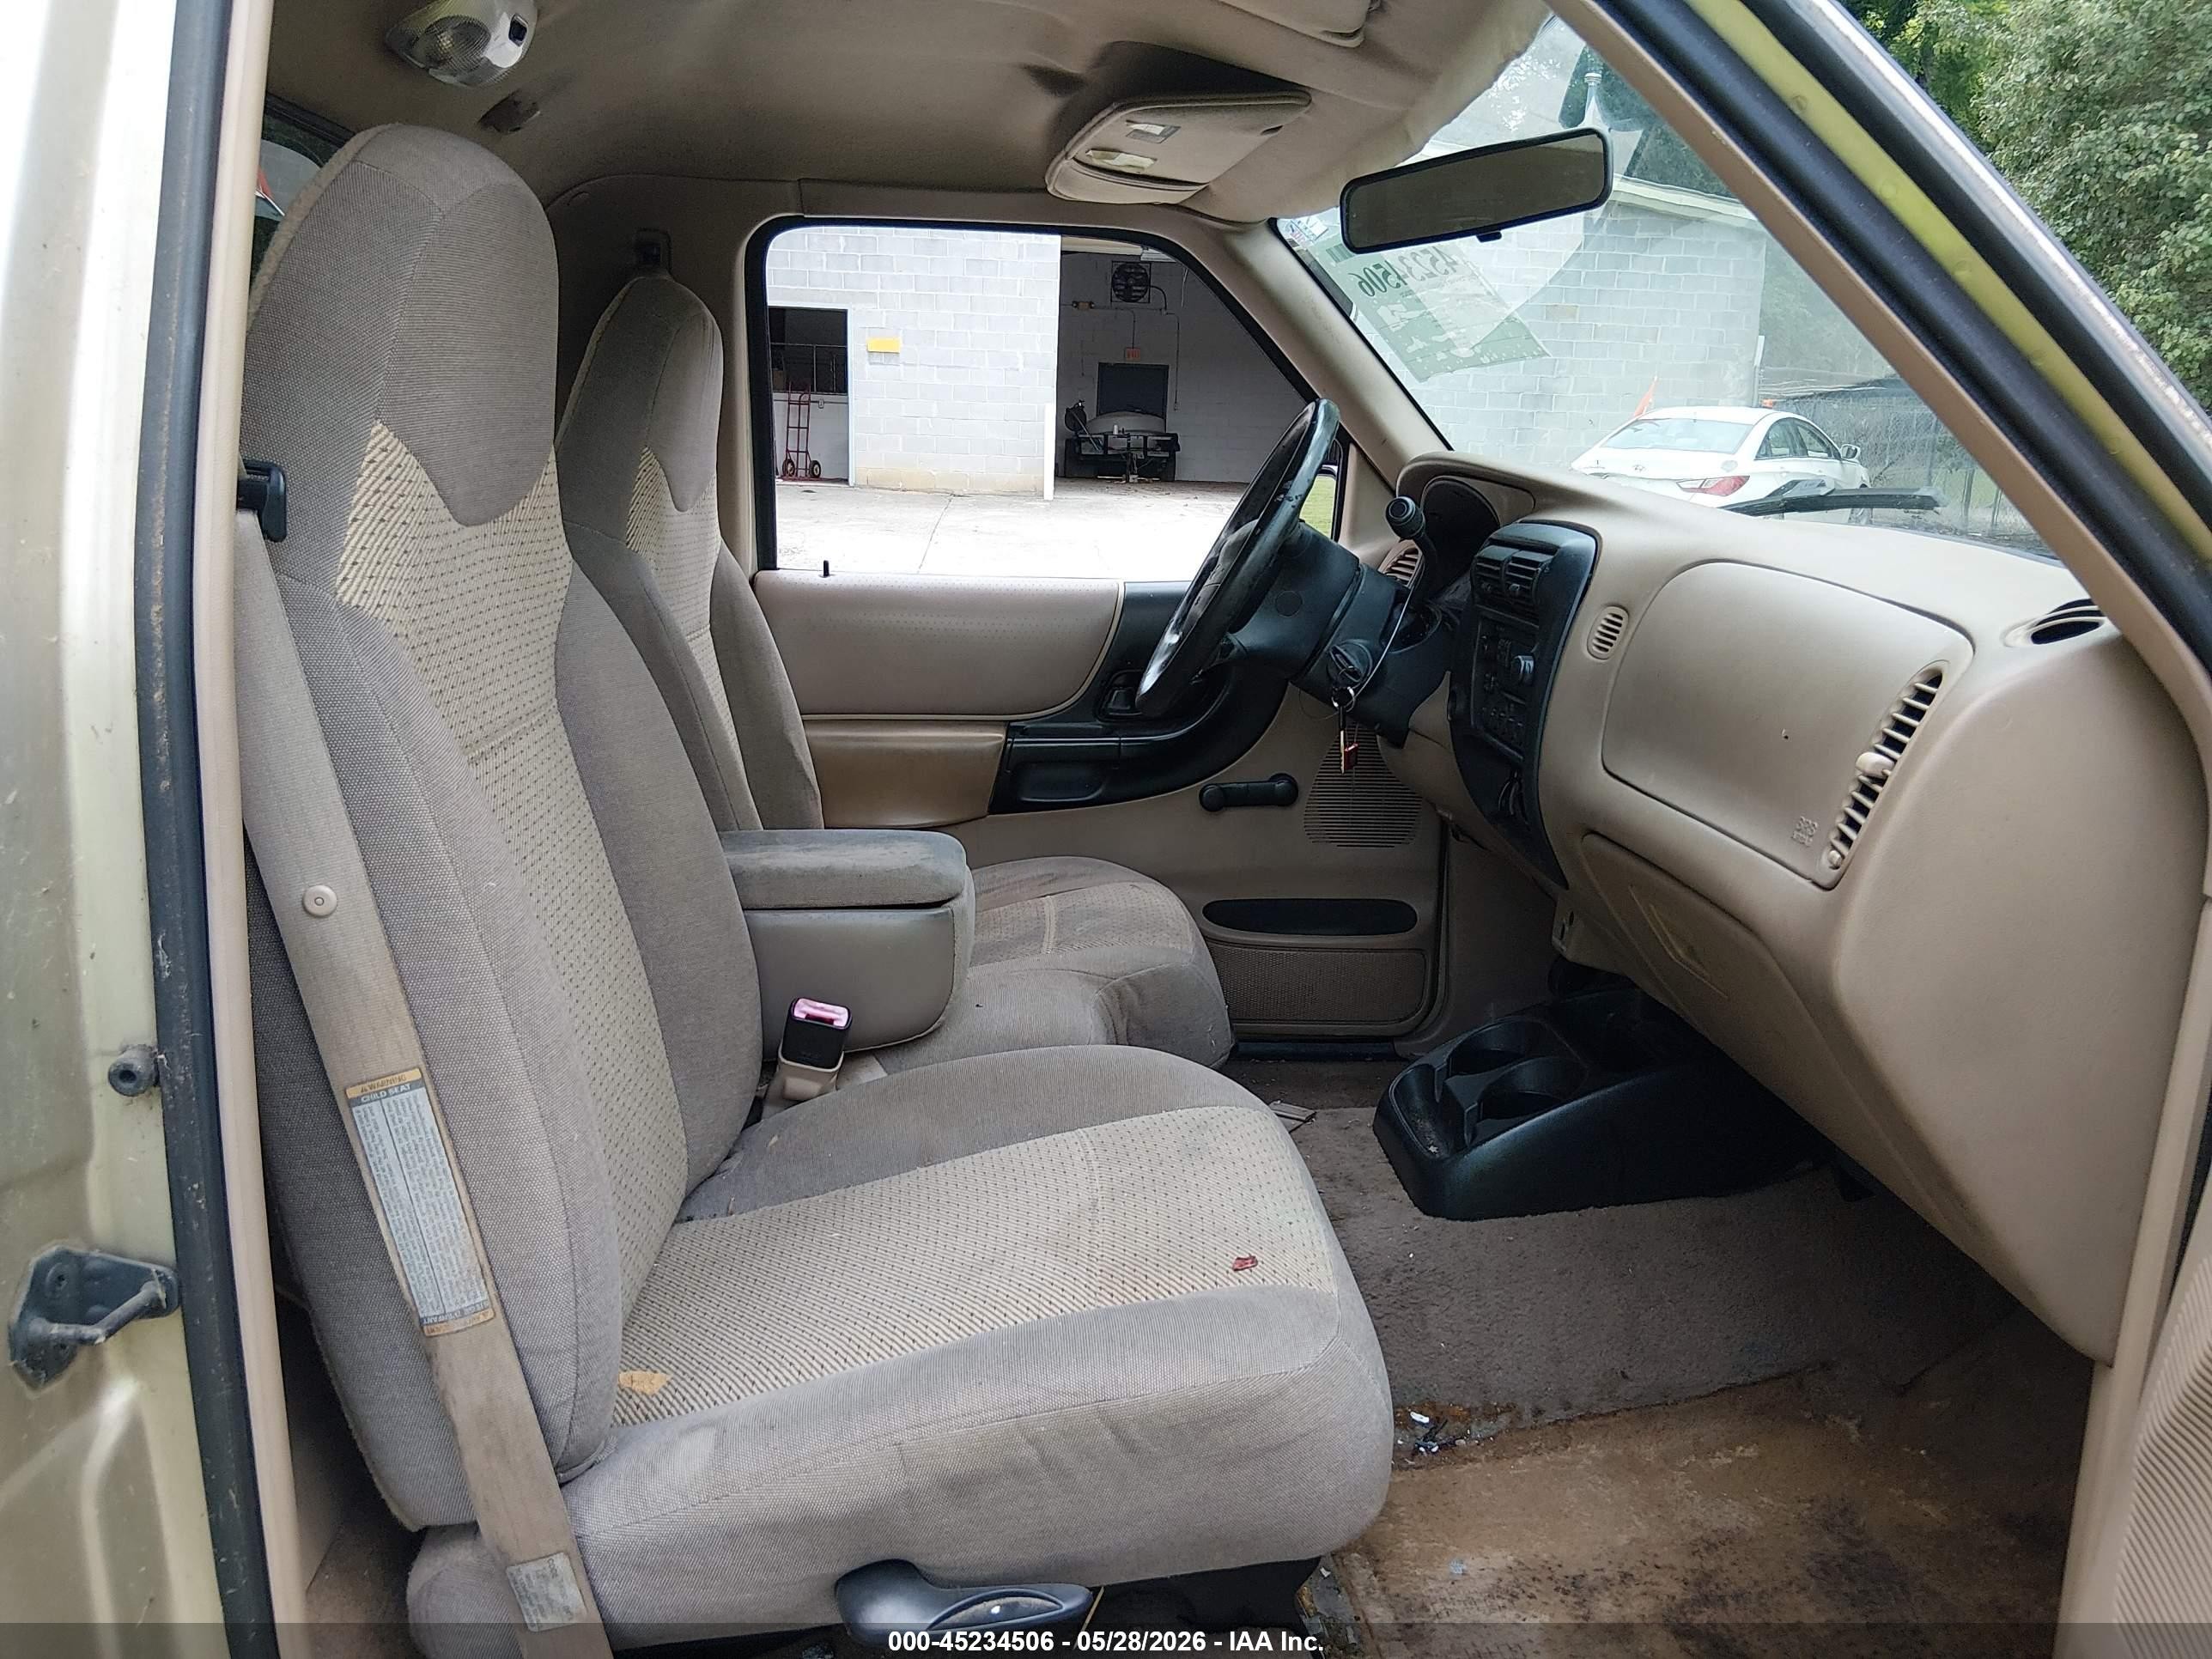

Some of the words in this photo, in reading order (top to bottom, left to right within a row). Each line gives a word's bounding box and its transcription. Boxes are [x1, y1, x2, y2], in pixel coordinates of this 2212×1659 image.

[368, 1073, 407, 1090] WARNING
[361, 1090, 387, 1103] CHILD
[388, 1083, 411, 1096] SEAT
